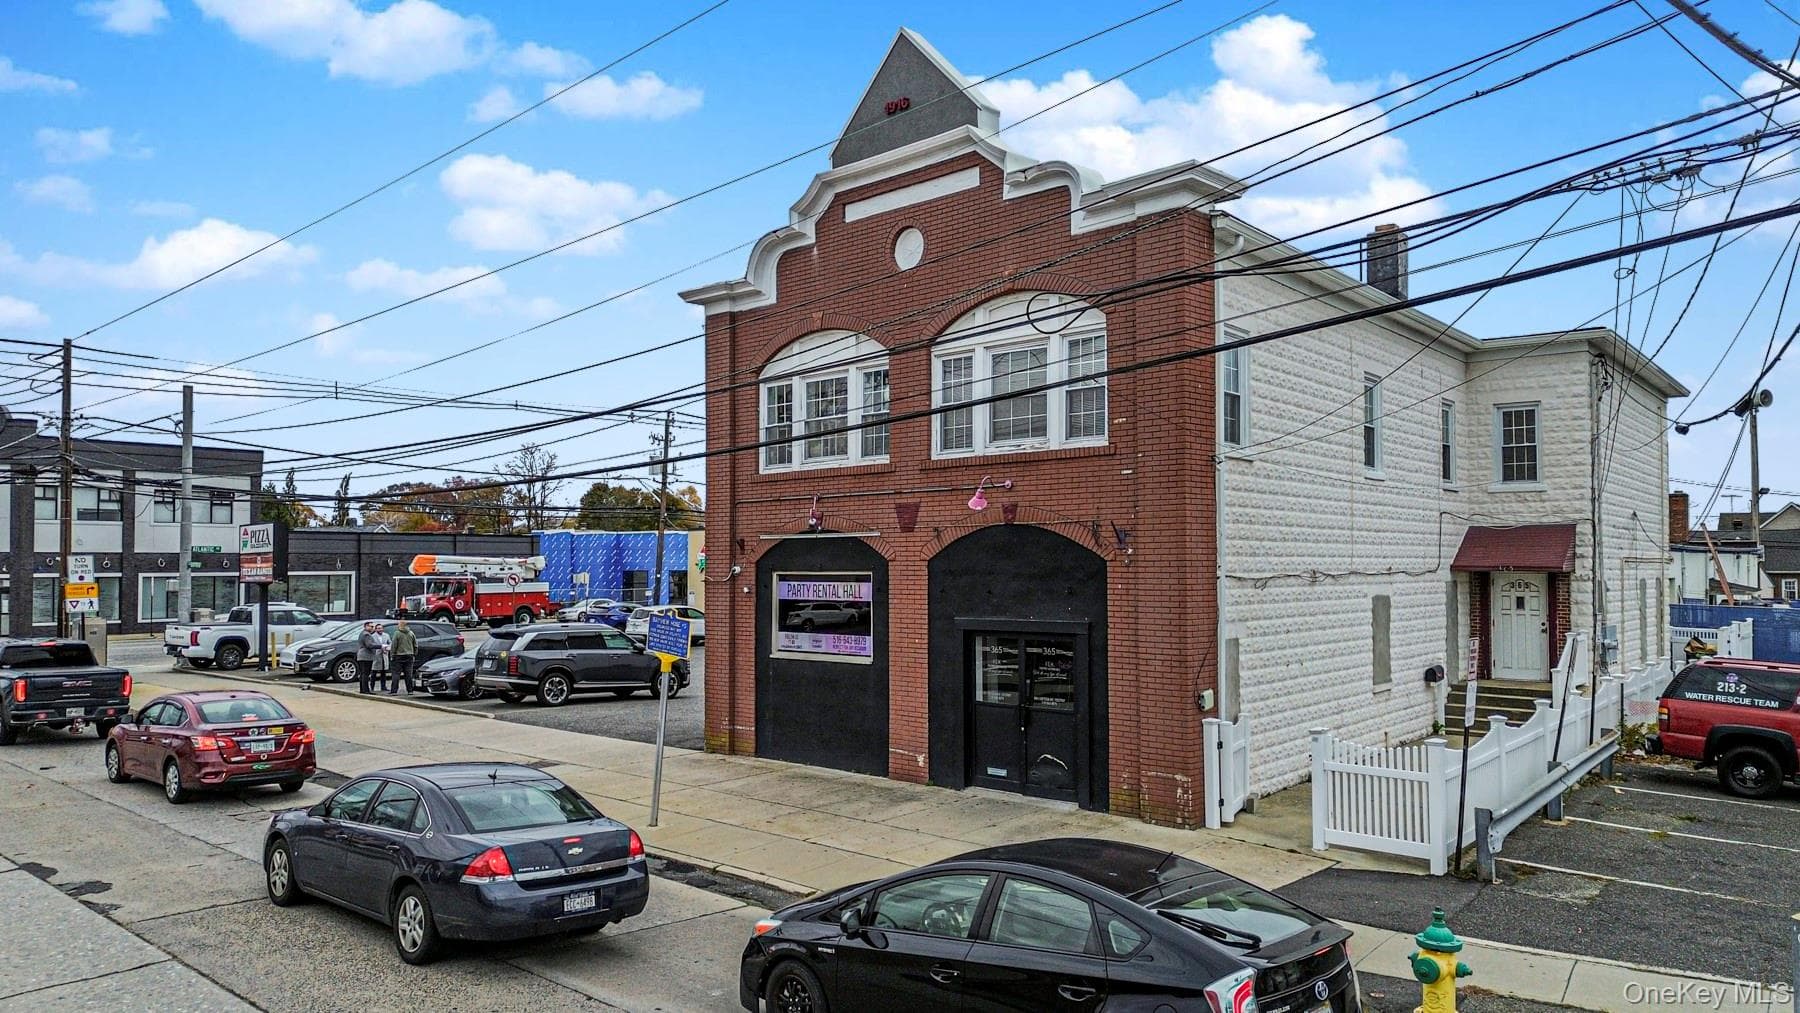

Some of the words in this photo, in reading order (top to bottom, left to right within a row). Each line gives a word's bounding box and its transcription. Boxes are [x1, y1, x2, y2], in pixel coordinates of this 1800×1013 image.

[885, 98, 910, 115] 1916
[250, 528, 271, 546] PIZZA
[787, 583, 811, 598] PARTY
[812, 583, 841, 599] RENTAL
[842, 584, 864, 599] HALL
[1510, 581, 1530, 589] 365
[990, 645, 1004, 655] 365
[1042, 646, 1057, 656] 365
[1717, 682, 1747, 694] 213-2
[1685, 692, 1713, 701] WATER
[1715, 695, 1752, 705] RESCUE
[1754, 699, 1779, 708] TEAM
